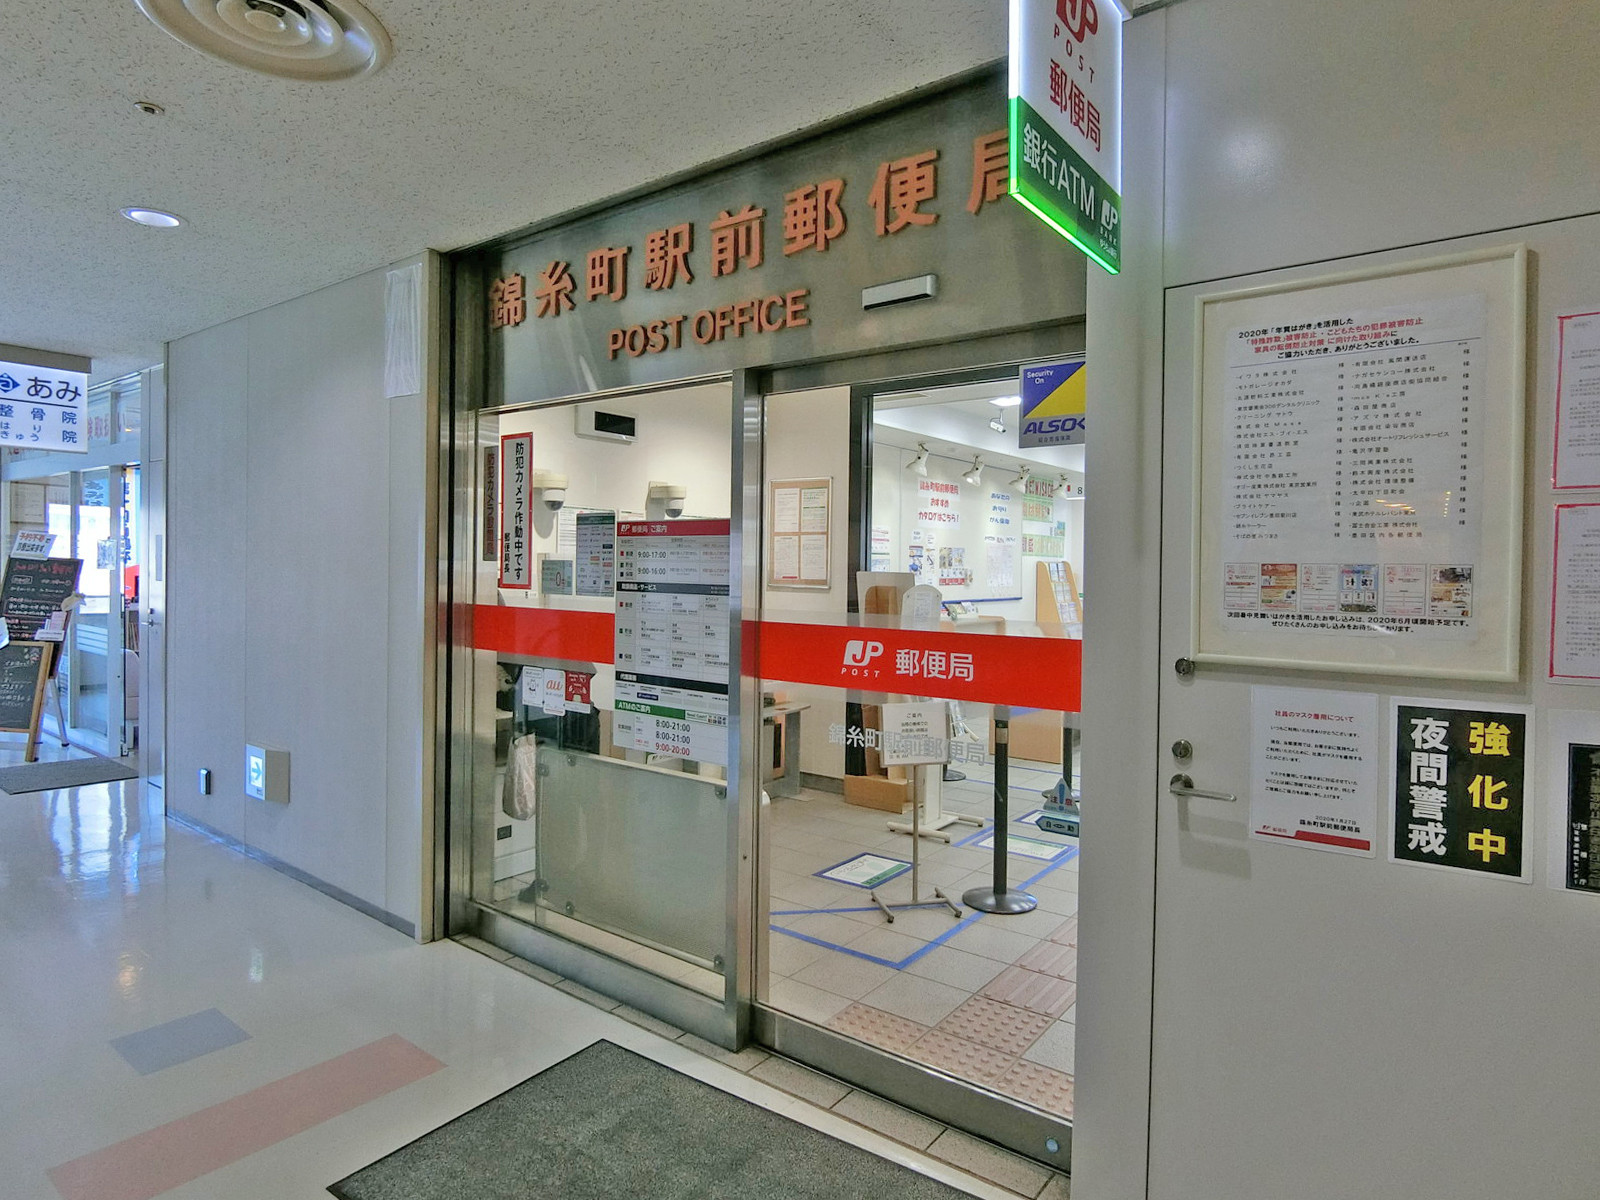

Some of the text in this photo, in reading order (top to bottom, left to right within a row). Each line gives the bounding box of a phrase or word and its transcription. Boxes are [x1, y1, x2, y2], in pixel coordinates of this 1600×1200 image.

[1053, 23, 1095, 83] POST
[1049, 58, 1101, 152] 郵便局
[1023, 121, 1095, 221] 銀行ATM
[608, 287, 811, 361] POST OFFICE
[1277, 336, 1419, 359] ご協力いただき、ありがとうございました。
[1026, 369, 1054, 379] Security
[27, 376, 82, 402] あみ
[0, 404, 77, 425] 整骨院
[62, 430, 77, 444] 院
[1077, 486, 1083, 495] 8
[930, 497, 949, 508] おすすめ
[514, 442, 525, 581] 防犯カメラ作動中です
[650, 524, 668, 533] ご案内
[638, 551, 667, 559] 9:00-17:00
[637, 567, 667, 575] 9:00-16:00
[842, 640, 884, 667] JP
[840, 667, 880, 678] POST
[895, 649, 974, 682] 郵便局
[1275, 709, 1355, 723] 社員のマスク着用について
[655, 720, 691, 733] 8:00-21:00
[655, 731, 691, 744] 8:00-21:00
[655, 742, 691, 756] 9:00-20:00
[1408, 716, 1449, 857] 夜間警戒
[1467, 721, 1511, 863] 強化中
[1299, 818, 1361, 834] 錦糸町駅前郵便局長
